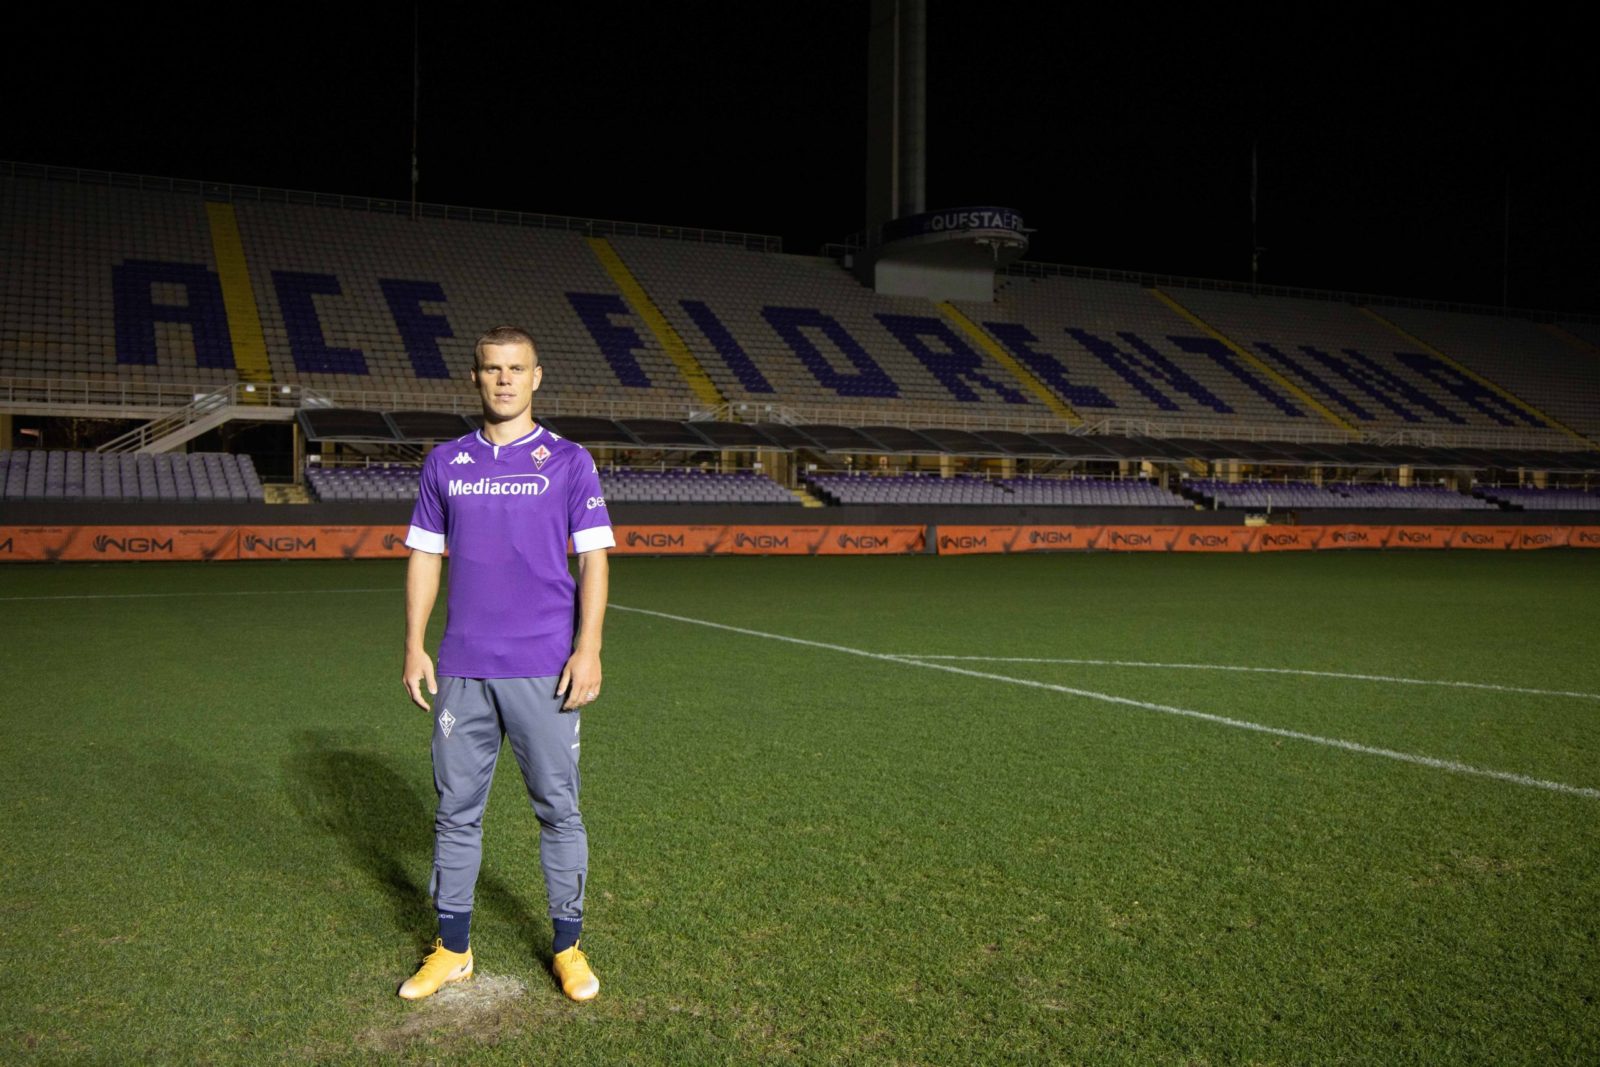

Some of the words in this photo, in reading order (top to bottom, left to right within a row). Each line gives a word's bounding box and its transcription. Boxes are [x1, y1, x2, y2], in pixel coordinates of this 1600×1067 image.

[111, 258, 456, 379] ACF
[565, 291, 1548, 427] FIORENTINA
[448, 477, 539, 497] Mediacom
[93, 534, 173, 553] NGM
[243, 533, 316, 552] NGM
[626, 531, 684, 547] NGM
[735, 532, 789, 549] NGM
[837, 532, 889, 549] NGM
[941, 535, 987, 549] NGM
[1030, 530, 1072, 544] NGM
[1111, 531, 1152, 545] NGM
[1189, 533, 1228, 547] NGM
[1398, 530, 1432, 543] NGM
[1462, 531, 1494, 544] NGM
[1579, 531, 1600, 543] NG
